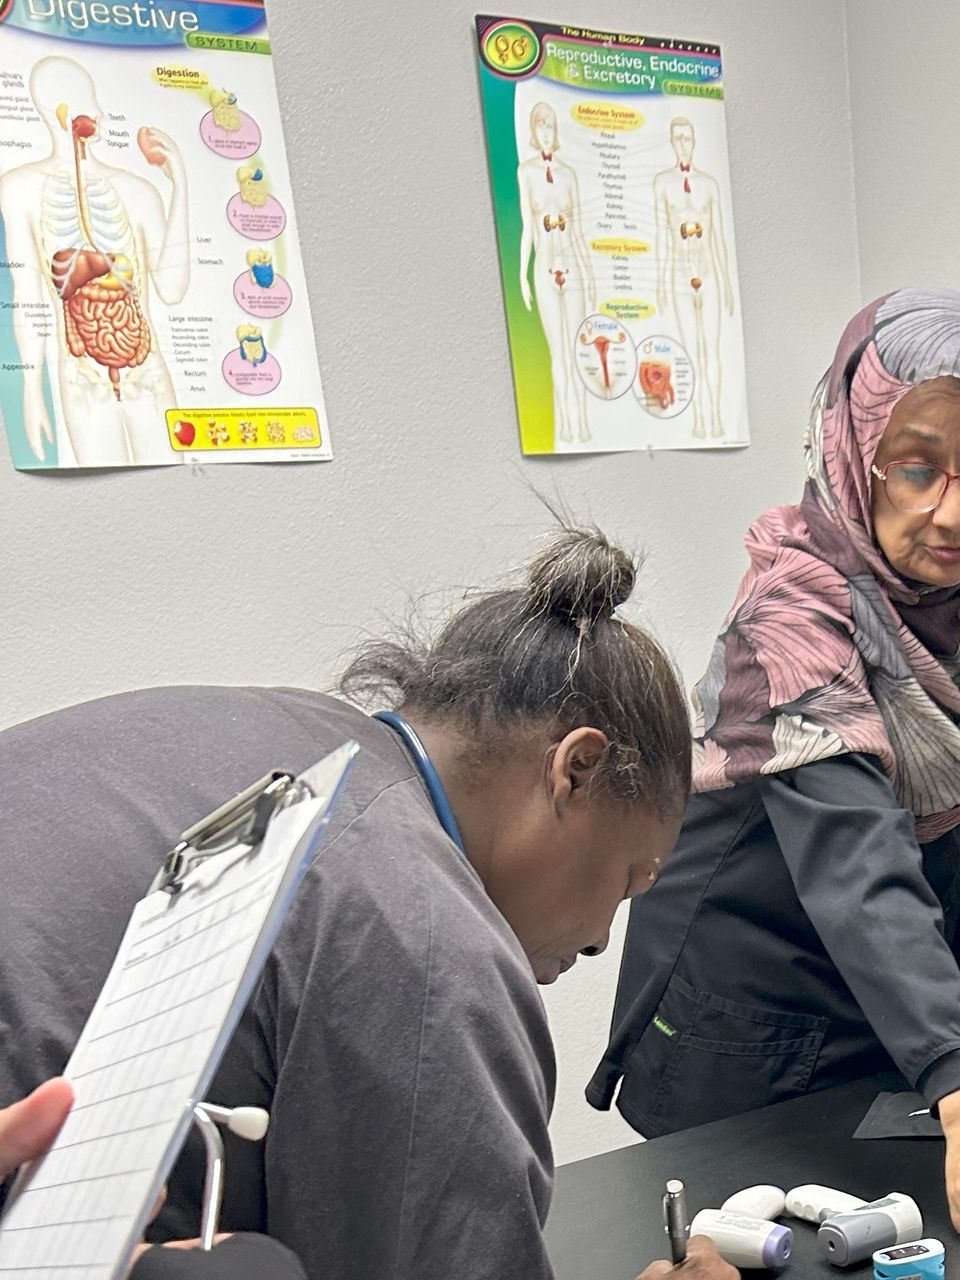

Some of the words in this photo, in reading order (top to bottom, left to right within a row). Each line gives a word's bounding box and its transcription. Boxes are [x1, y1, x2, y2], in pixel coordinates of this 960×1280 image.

[27, 0, 199, 31] Digestive
[561, 26, 580, 36] The
[582, 30, 616, 42] Human
[618, 34, 646, 46] Body
[194, 36, 258, 51] SYSTEM
[546, 43, 647, 71] Reproductive,
[156, 67, 200, 78] Digestion
[568, 64, 579, 78] &
[584, 65, 656, 89] Excretory
[669, 83, 722, 96] SYSTEMS
[109, 130, 129, 138] Mouth
[106, 140, 129, 149] Tongue
[594, 321, 618, 330] Female
[655, 345, 670, 353] Male
[2, 363, 35, 371] Appendix
